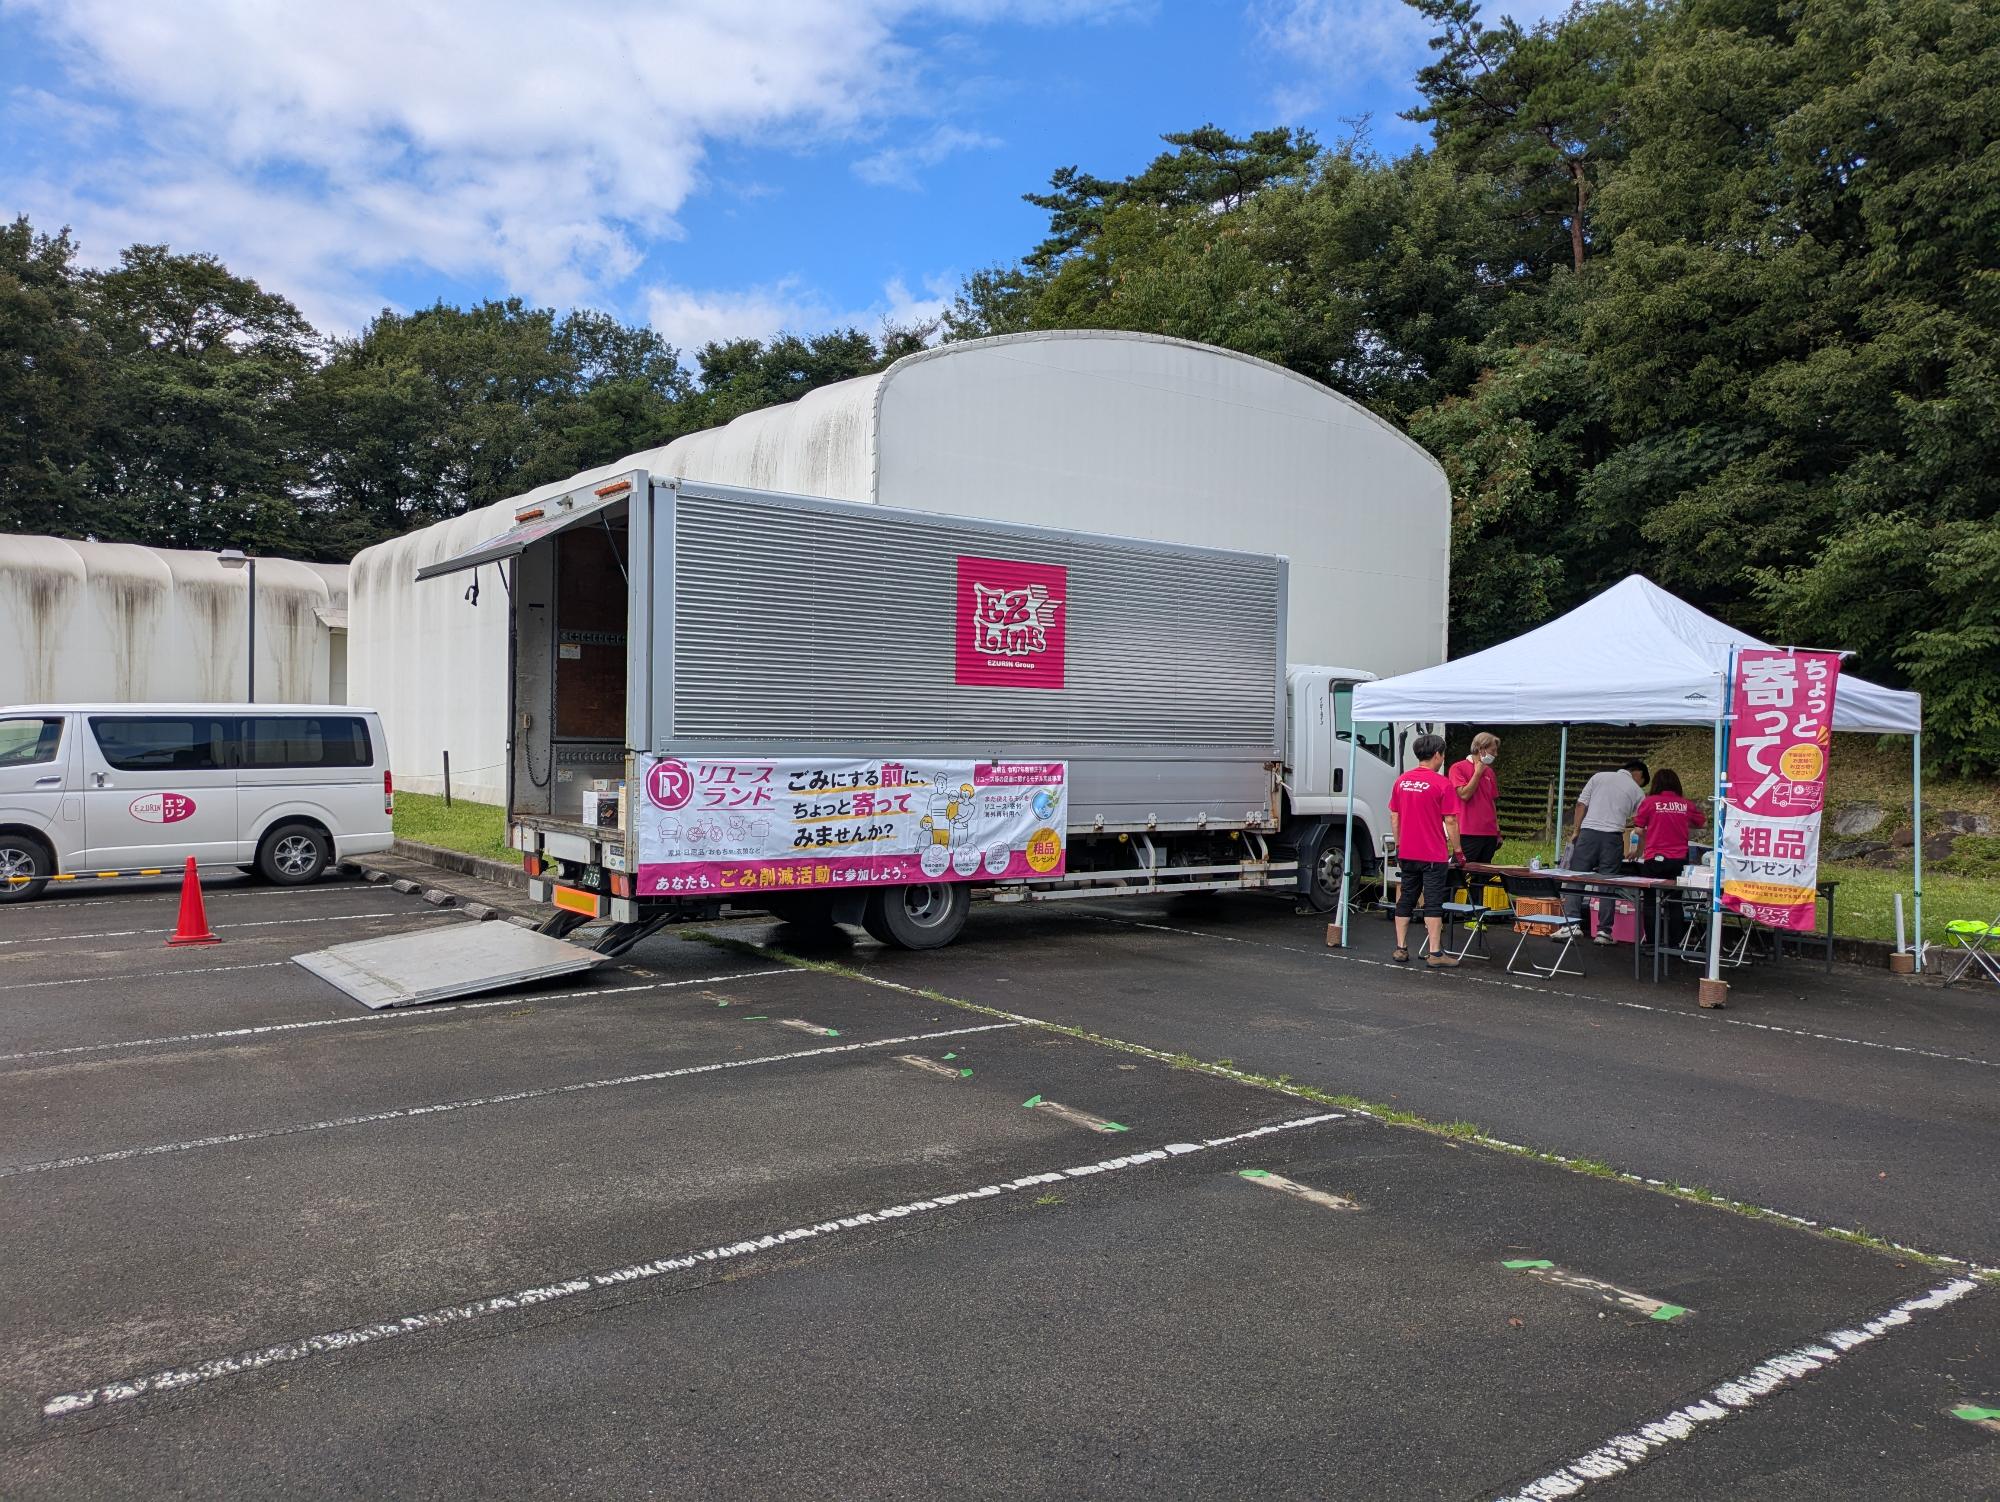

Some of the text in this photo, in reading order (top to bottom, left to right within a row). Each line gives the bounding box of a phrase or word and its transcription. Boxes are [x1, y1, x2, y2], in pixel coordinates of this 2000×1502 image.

[987, 660, 1035, 669] EZURIN Group
[1792, 658, 1828, 738] ちょっと
[698, 765, 774, 785] リユース
[787, 762, 926, 792] ごみにする前に、
[703, 787, 774, 807] ランド
[792, 792, 913, 820] ちょっと寄って
[1655, 801, 1688, 812] EZURIN
[793, 823, 894, 848] みませんか？
[1738, 825, 1806, 861] 粗品
[1032, 841, 1056, 856] 粗品
[655, 865, 908, 891] あなたも、ごみ削減活動に参加しよう。
[1736, 859, 1803, 879] プレゼント
[1757, 907, 1790, 918] リユース
[1759, 913, 1790, 925] ランド
